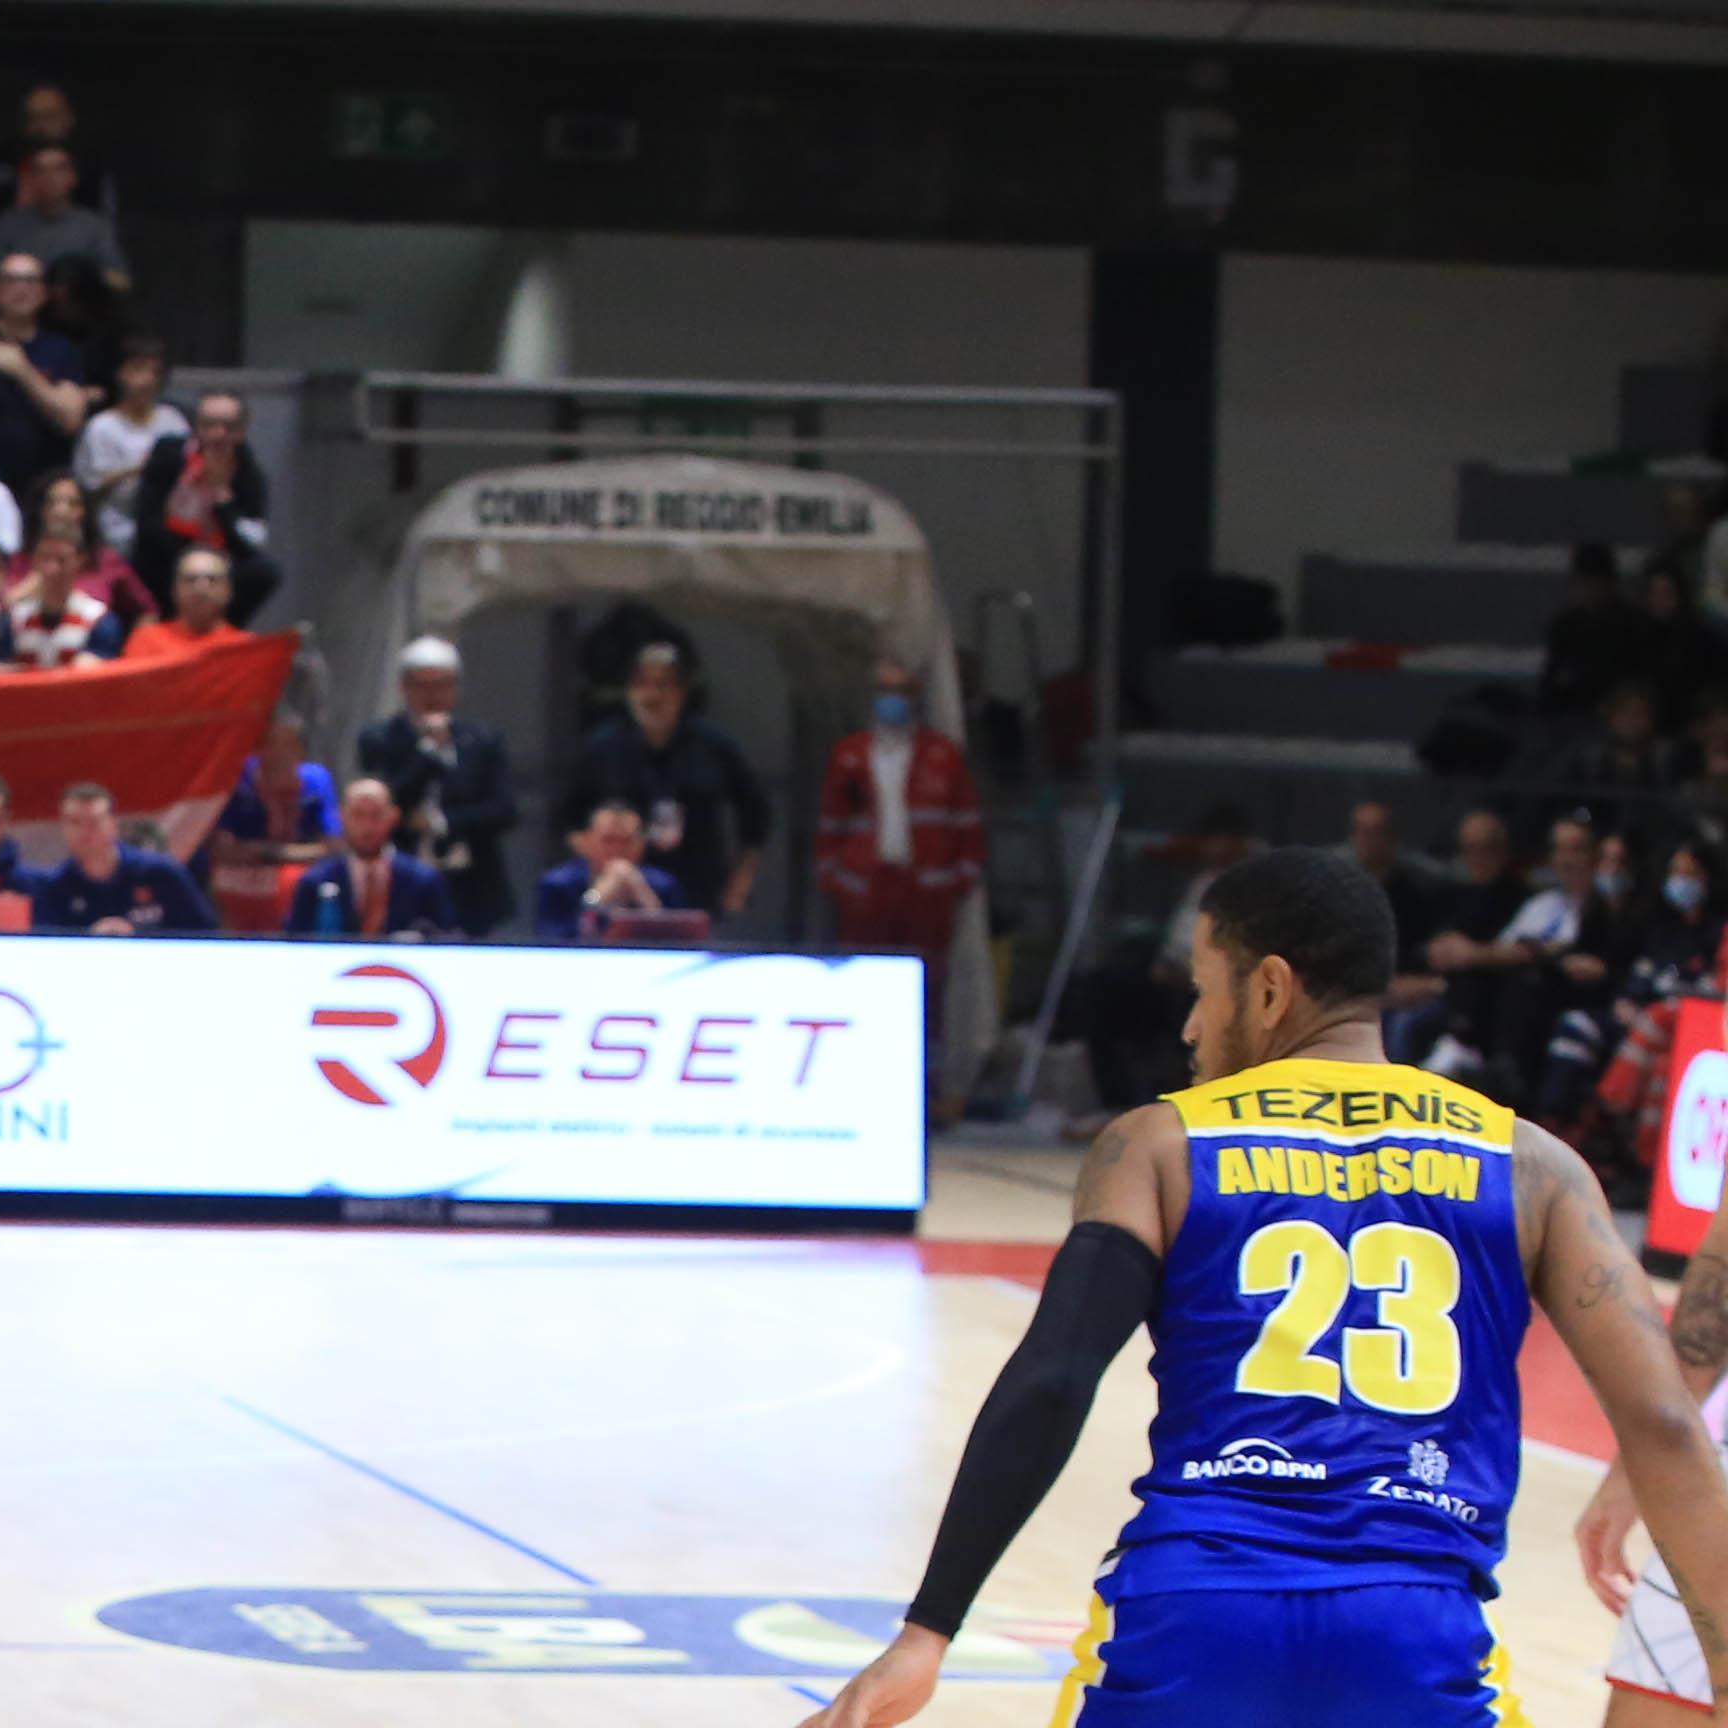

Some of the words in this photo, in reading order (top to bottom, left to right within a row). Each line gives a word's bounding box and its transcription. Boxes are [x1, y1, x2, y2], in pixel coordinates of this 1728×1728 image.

[1216, 1146, 1481, 1202] ANDERSON
[1234, 1219, 1462, 1416] 23
[1182, 1453, 1269, 1480] BANCO
[1270, 1460, 1326, 1480] BPM
